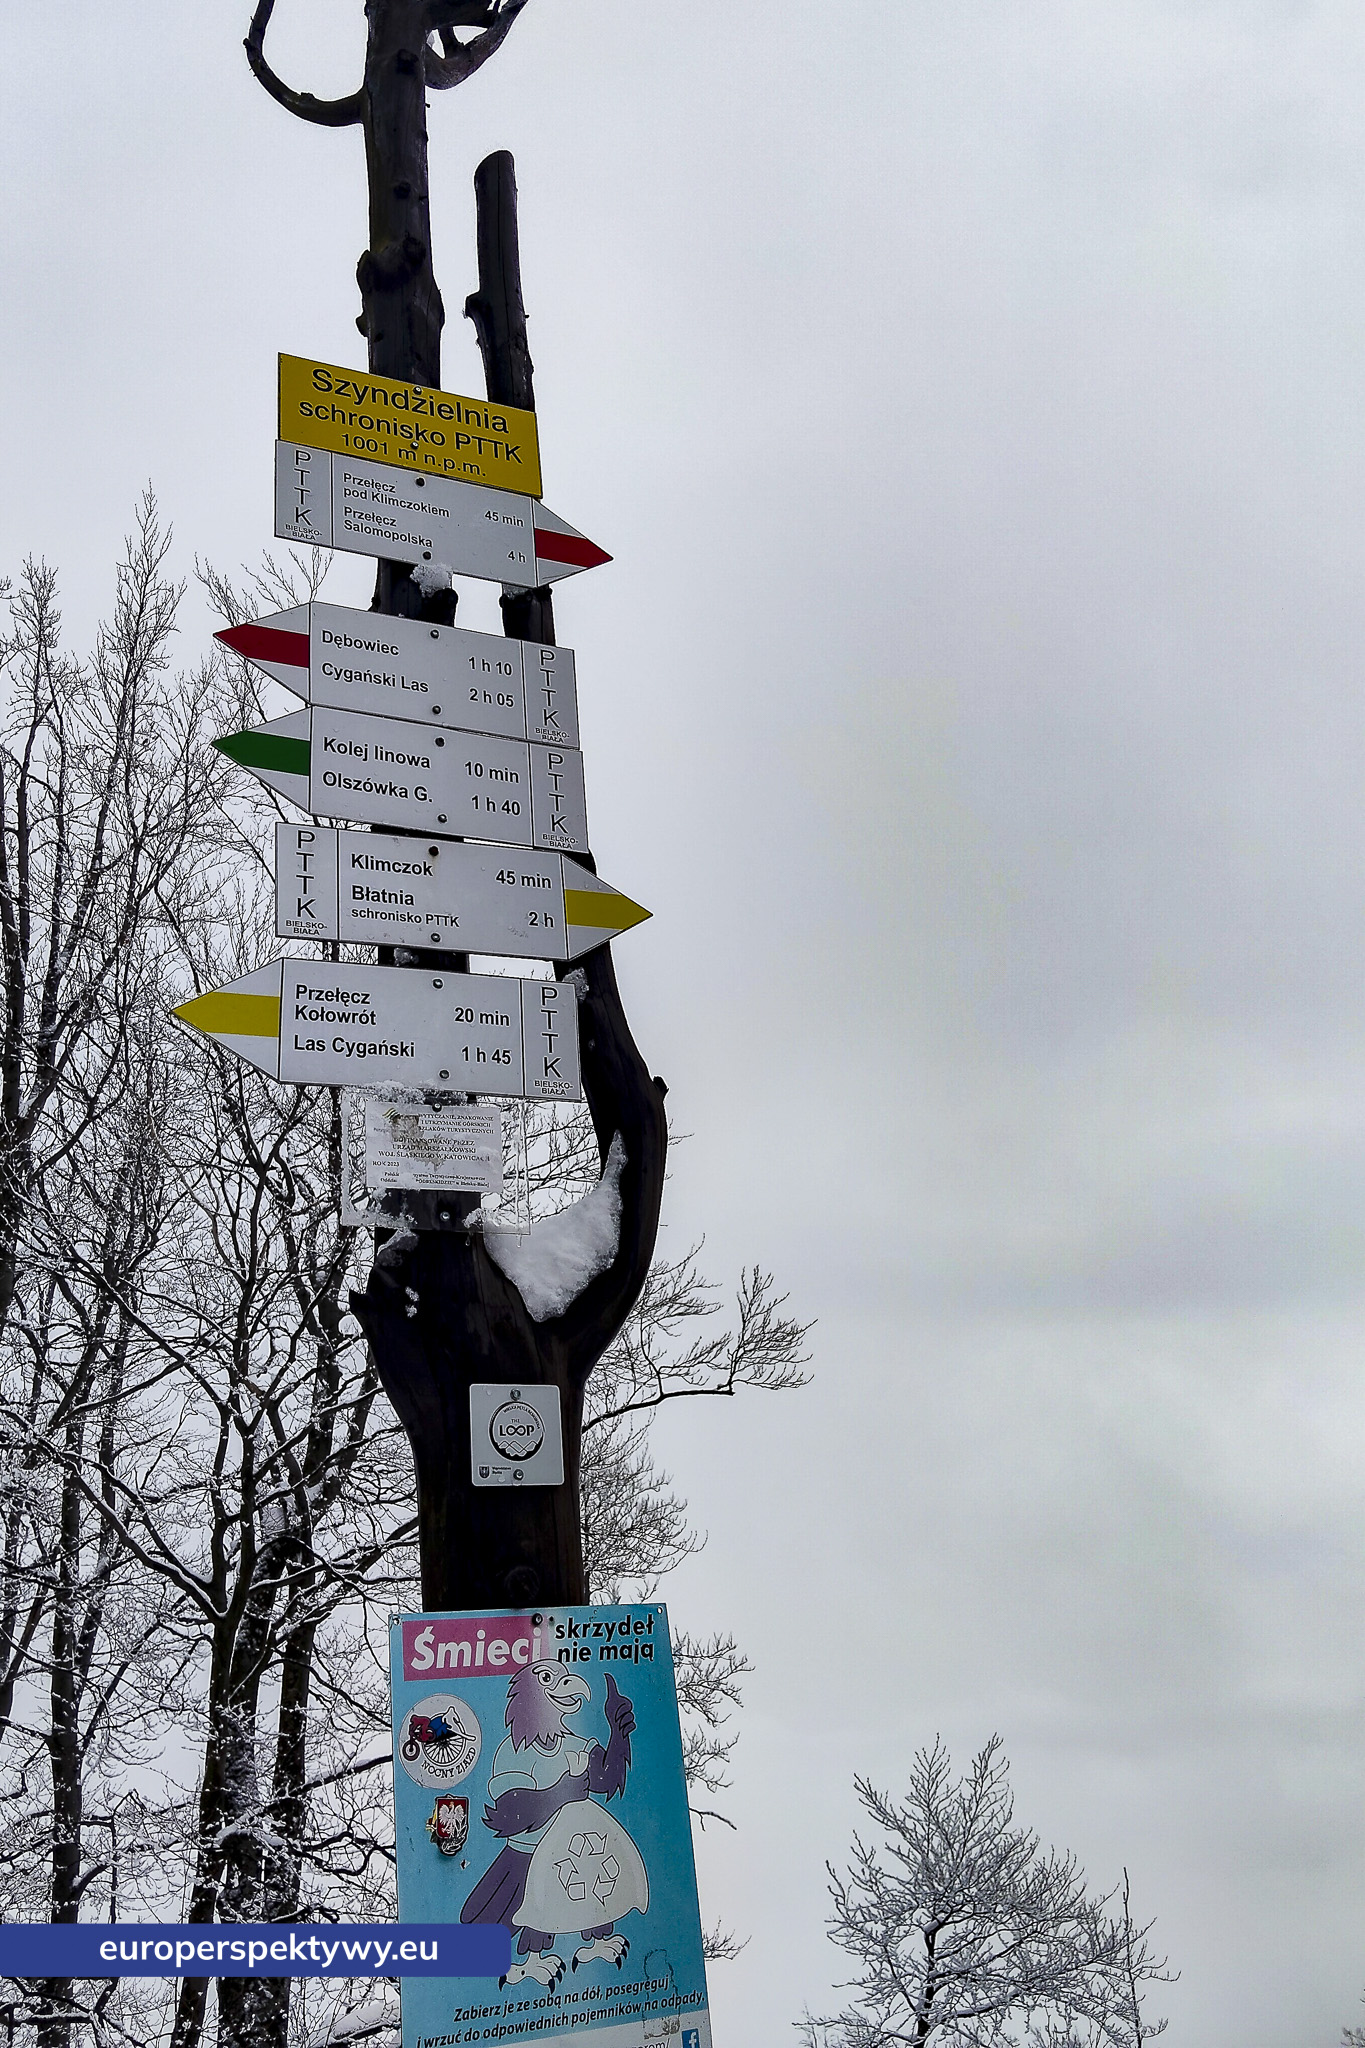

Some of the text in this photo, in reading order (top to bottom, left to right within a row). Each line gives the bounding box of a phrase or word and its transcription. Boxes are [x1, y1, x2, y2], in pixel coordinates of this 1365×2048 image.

[299, 401, 523, 464] schronisko PTTK
[342, 433, 486, 477] 1001 m n.p.m.
[293, 449, 312, 526] PTTK
[343, 472, 396, 494] Przełęcz
[343, 487, 450, 518] pod Klimczokiem
[344, 506, 397, 528] Przełęcz
[484, 510, 524, 528] 45 min
[285, 524, 323, 537] BIELSKO-
[292, 531, 316, 541] BIAŁA
[343, 520, 433, 548] Salomopolska
[508, 551, 526, 563] 4 h
[322, 630, 399, 655] Dębowiec
[468, 656, 512, 676] 1 h 10
[322, 662, 429, 693] Cygański Las
[469, 688, 514, 707] 2 h 05
[539, 650, 560, 728] PTTK
[535, 727, 570, 738] BIELSKO-
[541, 734, 564, 744] BIAŁA
[323, 737, 431, 768] Kolej linowa
[464, 761, 519, 784] 10 min
[322, 771, 433, 803] Olszówka G.
[548, 753, 569, 834] PTTK
[471, 795, 521, 816] 1 h 40
[542, 833, 578, 845] BIELSKO-
[549, 840, 573, 850] BIAŁA
[296, 830, 316, 919] PTTK
[351, 853, 551, 889] Klimczok 45 min
[351, 885, 415, 906] Błatnia
[285, 920, 327, 930] BIELSKO-
[351, 907, 460, 928] schronisko PTTK
[528, 911, 554, 928] 2 h
[293, 926, 320, 936] BIAŁA
[295, 983, 371, 1006] Przełęcz
[295, 1004, 376, 1026] Kołowrót
[454, 1007, 510, 1026] 20 min
[540, 986, 563, 1078] PTTK
[294, 1034, 415, 1059] Las Cygański
[461, 1046, 512, 1065] 1 h 45
[534, 1080, 573, 1089] BIELSKO-
[541, 1087, 566, 1096] BIAŁA
[499, 1424, 535, 1436] LOOP
[411, 1613, 654, 1671] Śmieci skrzydeł
[557, 1638, 654, 1664] nie mają
[421, 1747, 476, 1779] NOCNY ZJAZD
[454, 1975, 669, 2022] Zabierz je ze sobą na dół, posegreguj
[416, 1992, 705, 2048] i wrzuć do odpowiednich pojemników na odpady.
